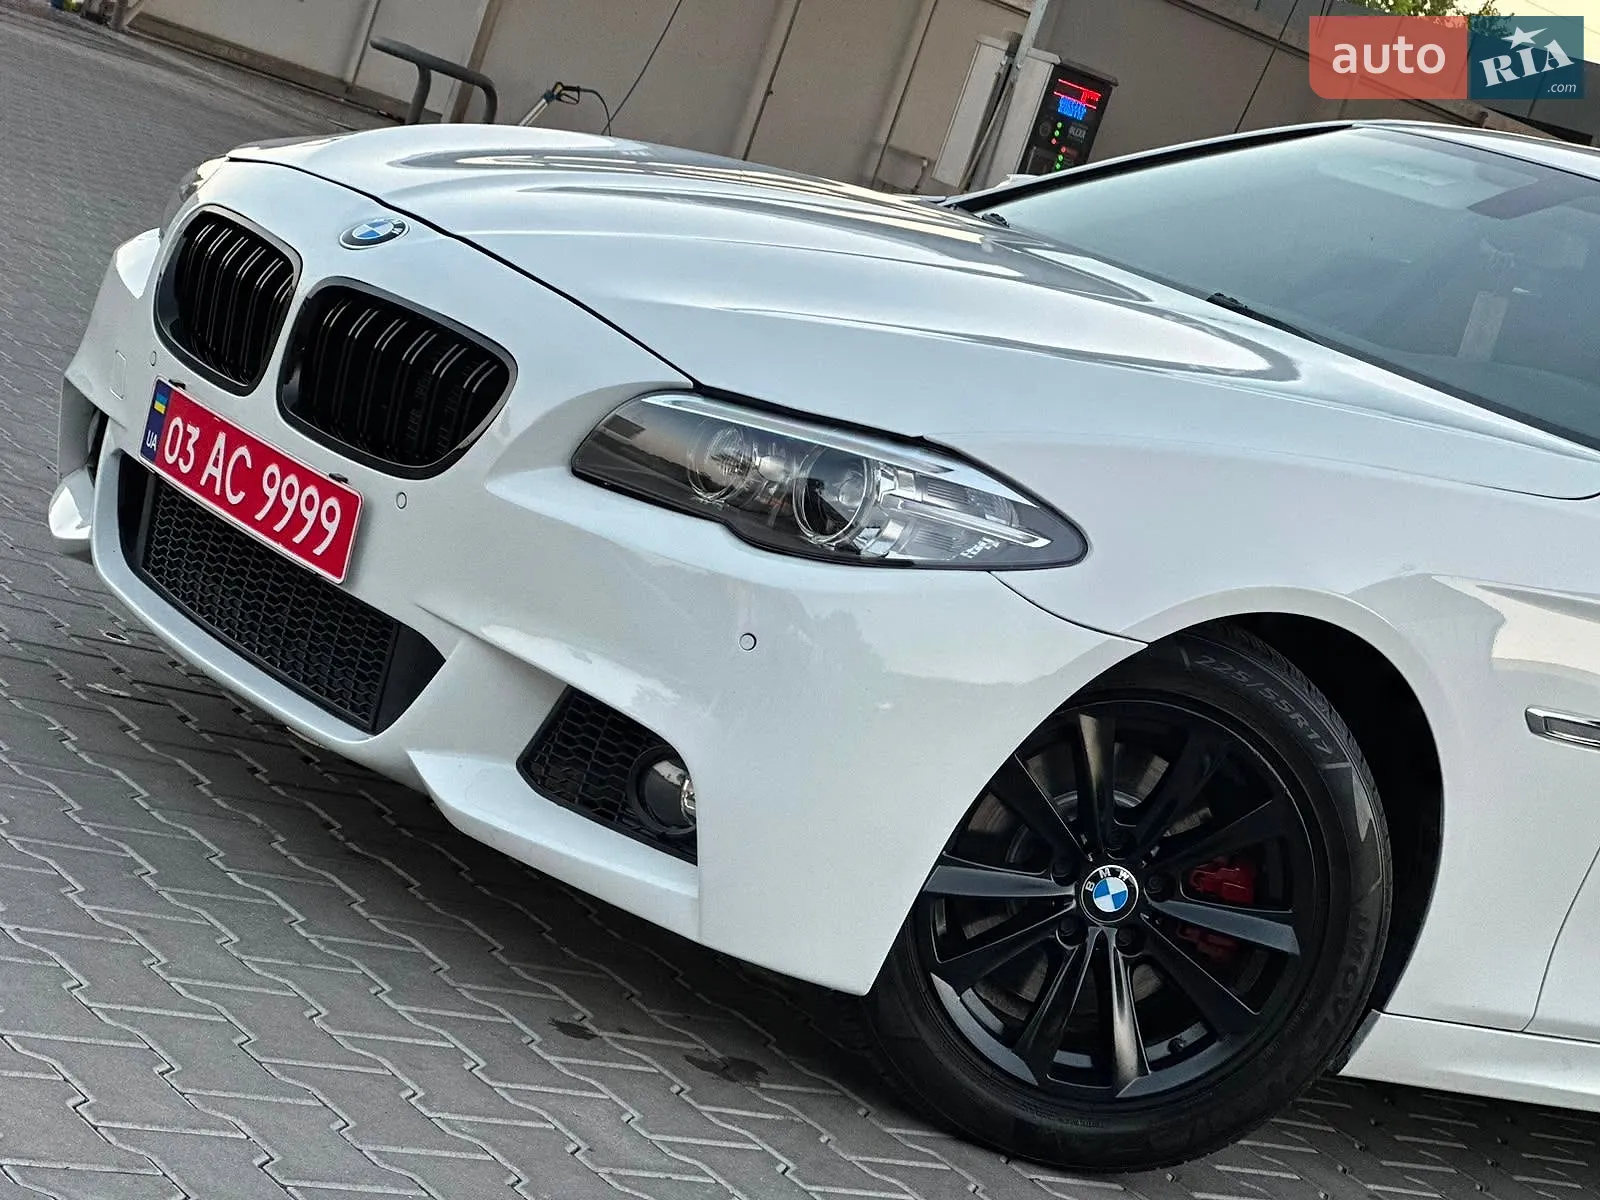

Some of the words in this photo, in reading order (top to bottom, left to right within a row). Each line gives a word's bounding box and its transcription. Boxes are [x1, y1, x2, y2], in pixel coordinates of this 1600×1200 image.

[146, 430, 157, 452] UA
[164, 416, 200, 474] 03
[200, 431, 252, 505] AC
[254, 463, 341, 556] 9999
[1195, 655, 1333, 755] 225/55R17
[1085, 867, 1130, 892] BMW
